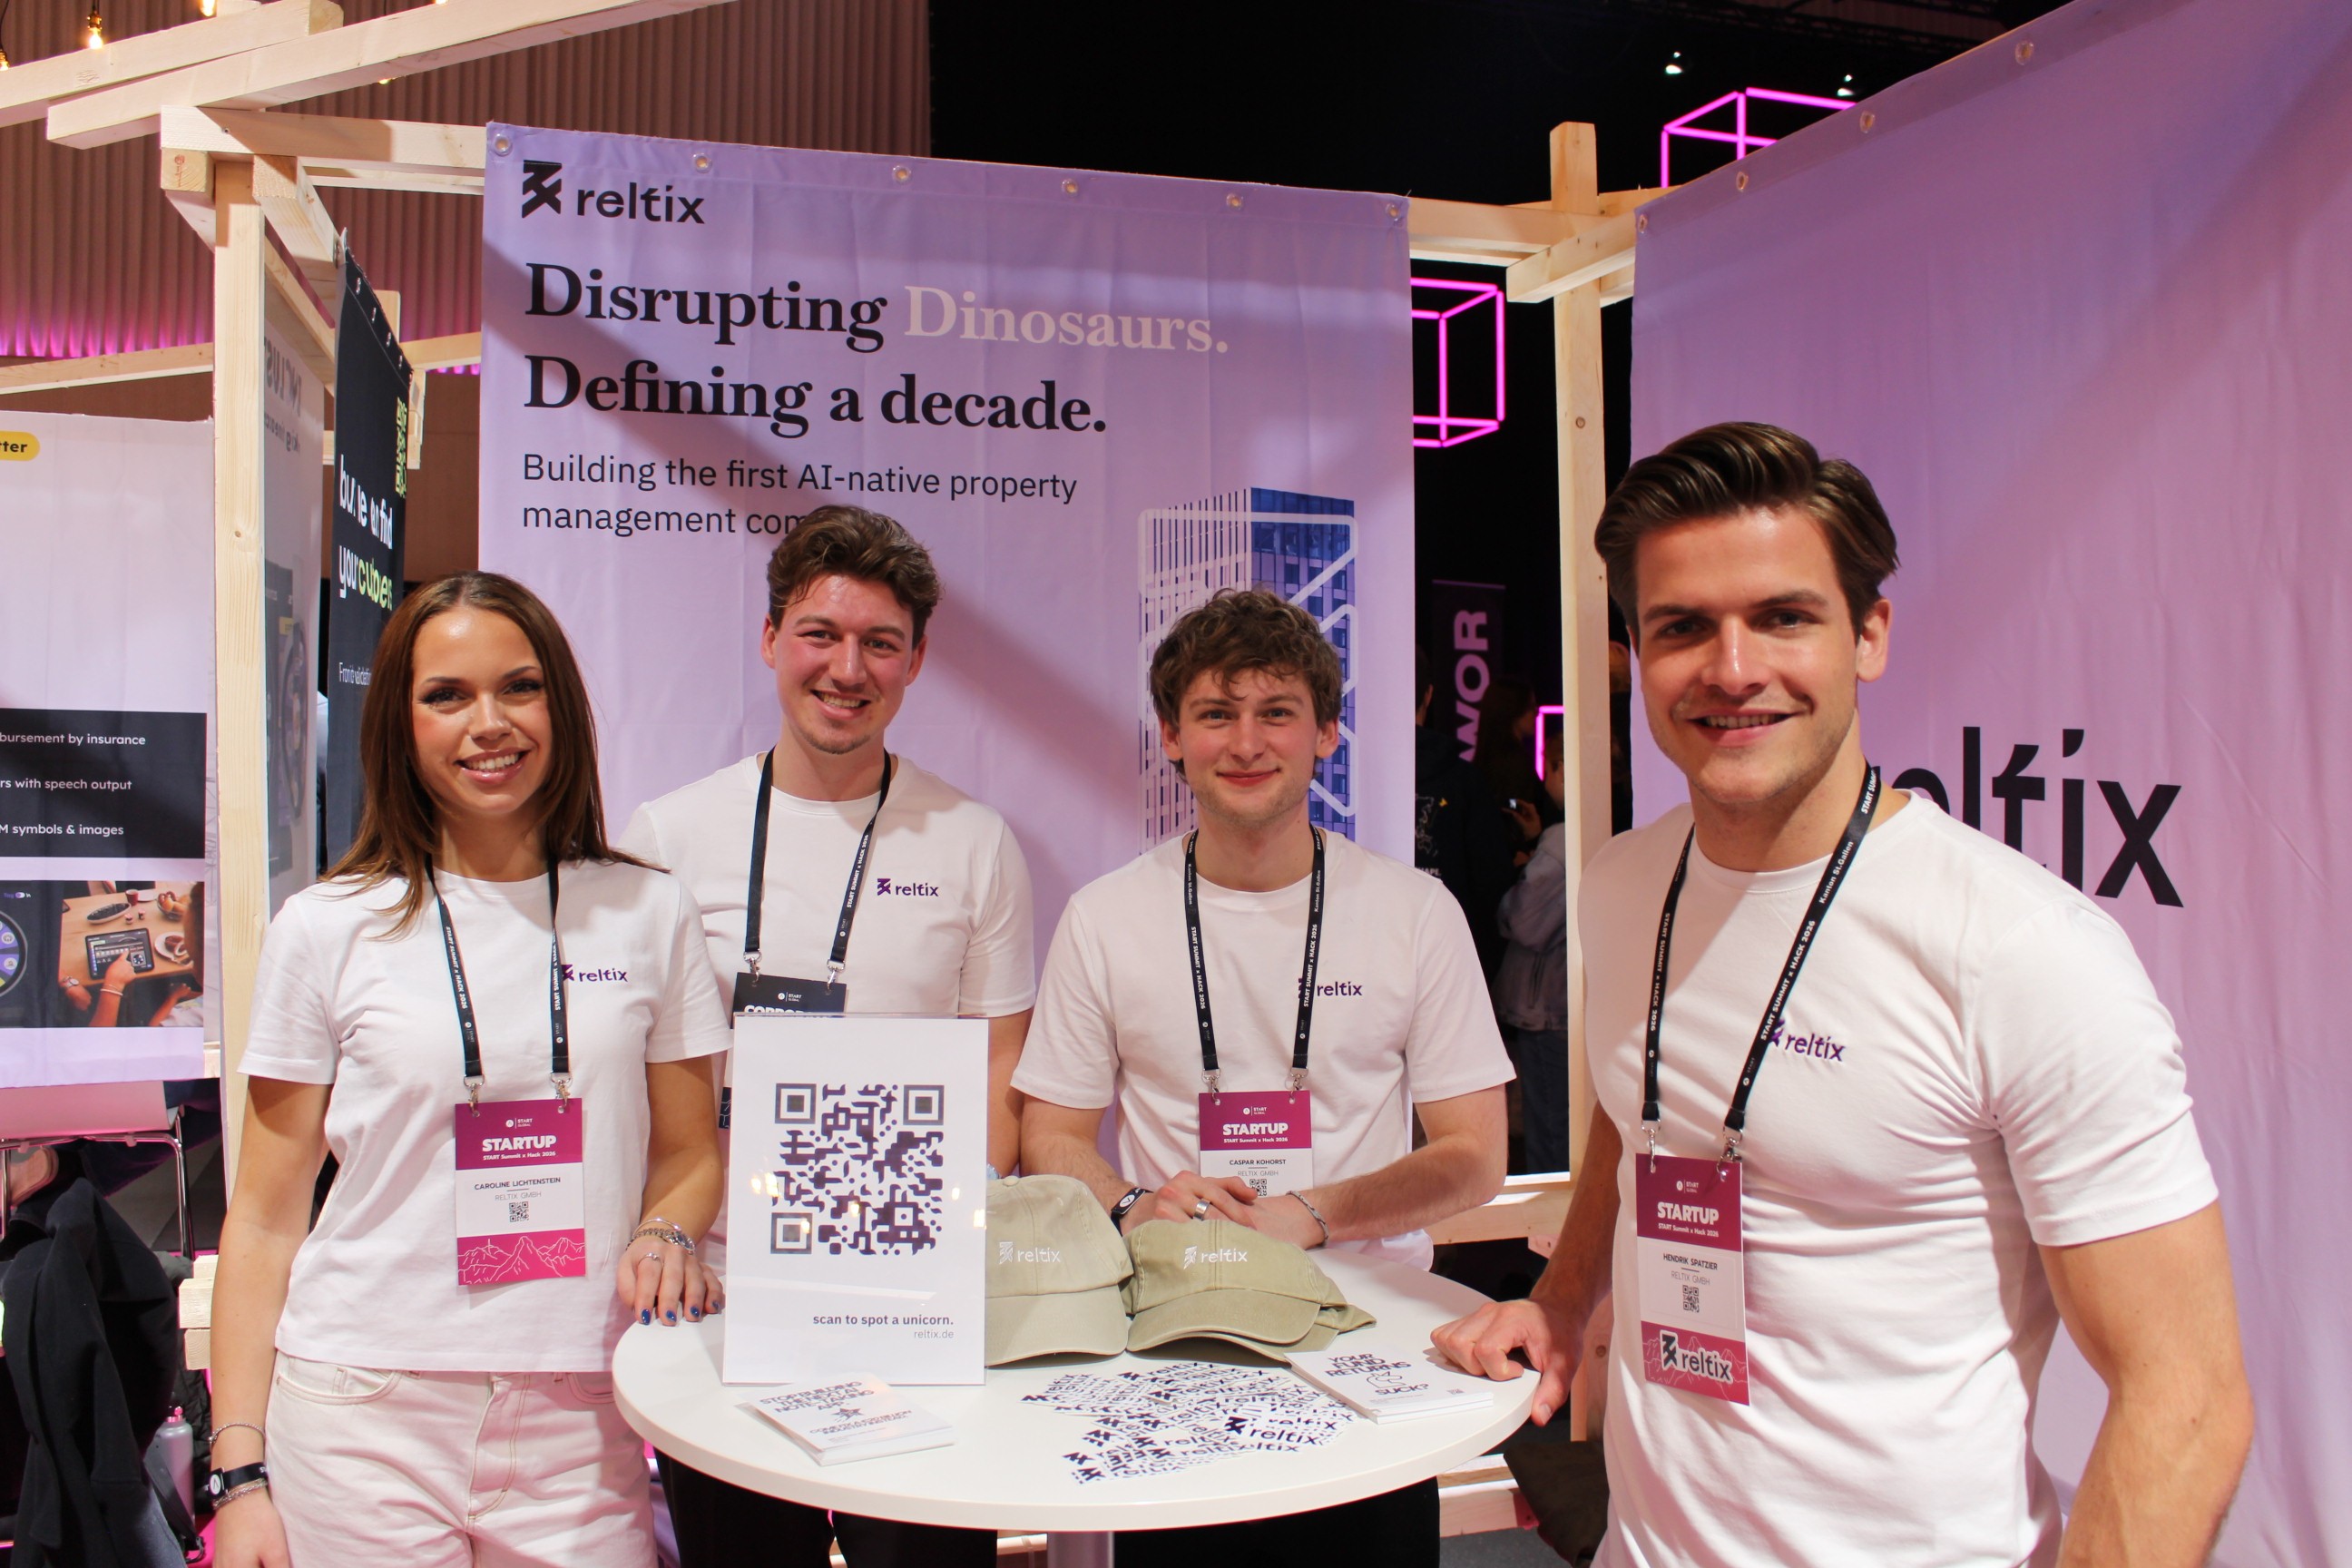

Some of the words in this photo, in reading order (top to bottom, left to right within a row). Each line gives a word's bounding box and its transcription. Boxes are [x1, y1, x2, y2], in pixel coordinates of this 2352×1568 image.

[577, 181, 705, 224] reltix
[525, 262, 887, 353] Disrupting
[904, 285, 1228, 353] Dinosaurs.
[524, 355, 813, 438] Defining
[829, 387, 864, 422] a
[880, 373, 1106, 432] decade.
[0, 441, 27, 453] ter
[524, 454, 656, 491] Building
[665, 458, 717, 486] the
[727, 460, 788, 488] first
[798, 464, 940, 494] AI-native
[951, 474, 1077, 505] property
[523, 506, 736, 537] management
[68, 733, 83, 746] by
[87, 733, 145, 745] insurance
[15, 778, 41, 789] with
[44, 779, 87, 791] speech
[91, 779, 132, 792] output
[1861, 791, 1873, 814] START
[1869, 726, 2184, 907] ltix
[13, 824, 63, 837] symbols
[66, 824, 75, 834] &
[79, 824, 123, 838] images
[850, 869, 860, 891] SUMMIT
[895, 882, 939, 897] reltix
[1818, 877, 1837, 904] Kanton
[847, 891, 855, 908] START
[1661, 913, 1671, 937] START
[446, 926, 454, 945] START
[456, 975, 465, 992] HACK
[1657, 940, 1666, 972] SUMMIT
[579, 968, 628, 983] reltix
[1760, 1014, 1776, 1041] START
[1772, 978, 1790, 1012] SUMMIT
[1790, 944, 1806, 969] HACK
[1802, 920, 1816, 942] 2026
[1317, 981, 1363, 997] reltix
[1652, 983, 1661, 1006] HACK
[1785, 1033, 1846, 1062] reltix
[1222, 1122, 1289, 1136] STARTUP
[482, 1134, 557, 1152] STARTUP
[474, 1181, 511, 1191] CAROLINE
[512, 1177, 562, 1187] LICHTENSTEIN
[495, 1193, 519, 1201] RELTIX
[1657, 1201, 1720, 1226] STARTUP
[1658, 1222, 1672, 1230] START
[1672, 1225, 1690, 1233] Summit
[1706, 1229, 1720, 1238] 2026
[1017, 1247, 1062, 1263] reltix
[1200, 1248, 1248, 1263] reltix
[1662, 1252, 1689, 1265] HENDRIK
[1690, 1258, 1719, 1271] SPATZIER
[1671, 1270, 1690, 1282] RELTIX
[1692, 1274, 1710, 1286] GMBH
[813, 1315, 842, 1325] scan
[846, 1314, 858, 1325] to
[861, 1315, 888, 1328] spot
[892, 1316, 899, 1325] a
[903, 1314, 954, 1326] unicorn.
[914, 1328, 955, 1339] reltix.de
[1328, 1353, 1373, 1363] YOUR
[1331, 1357, 1386, 1369] FUND
[1681, 1351, 1731, 1381] reltix
[1324, 1361, 1412, 1377] RETURNS
[1375, 1383, 1429, 1396] SUCK?
[760, 1393, 798, 1405] STOP
[1250, 1428, 1319, 1446] reltix
